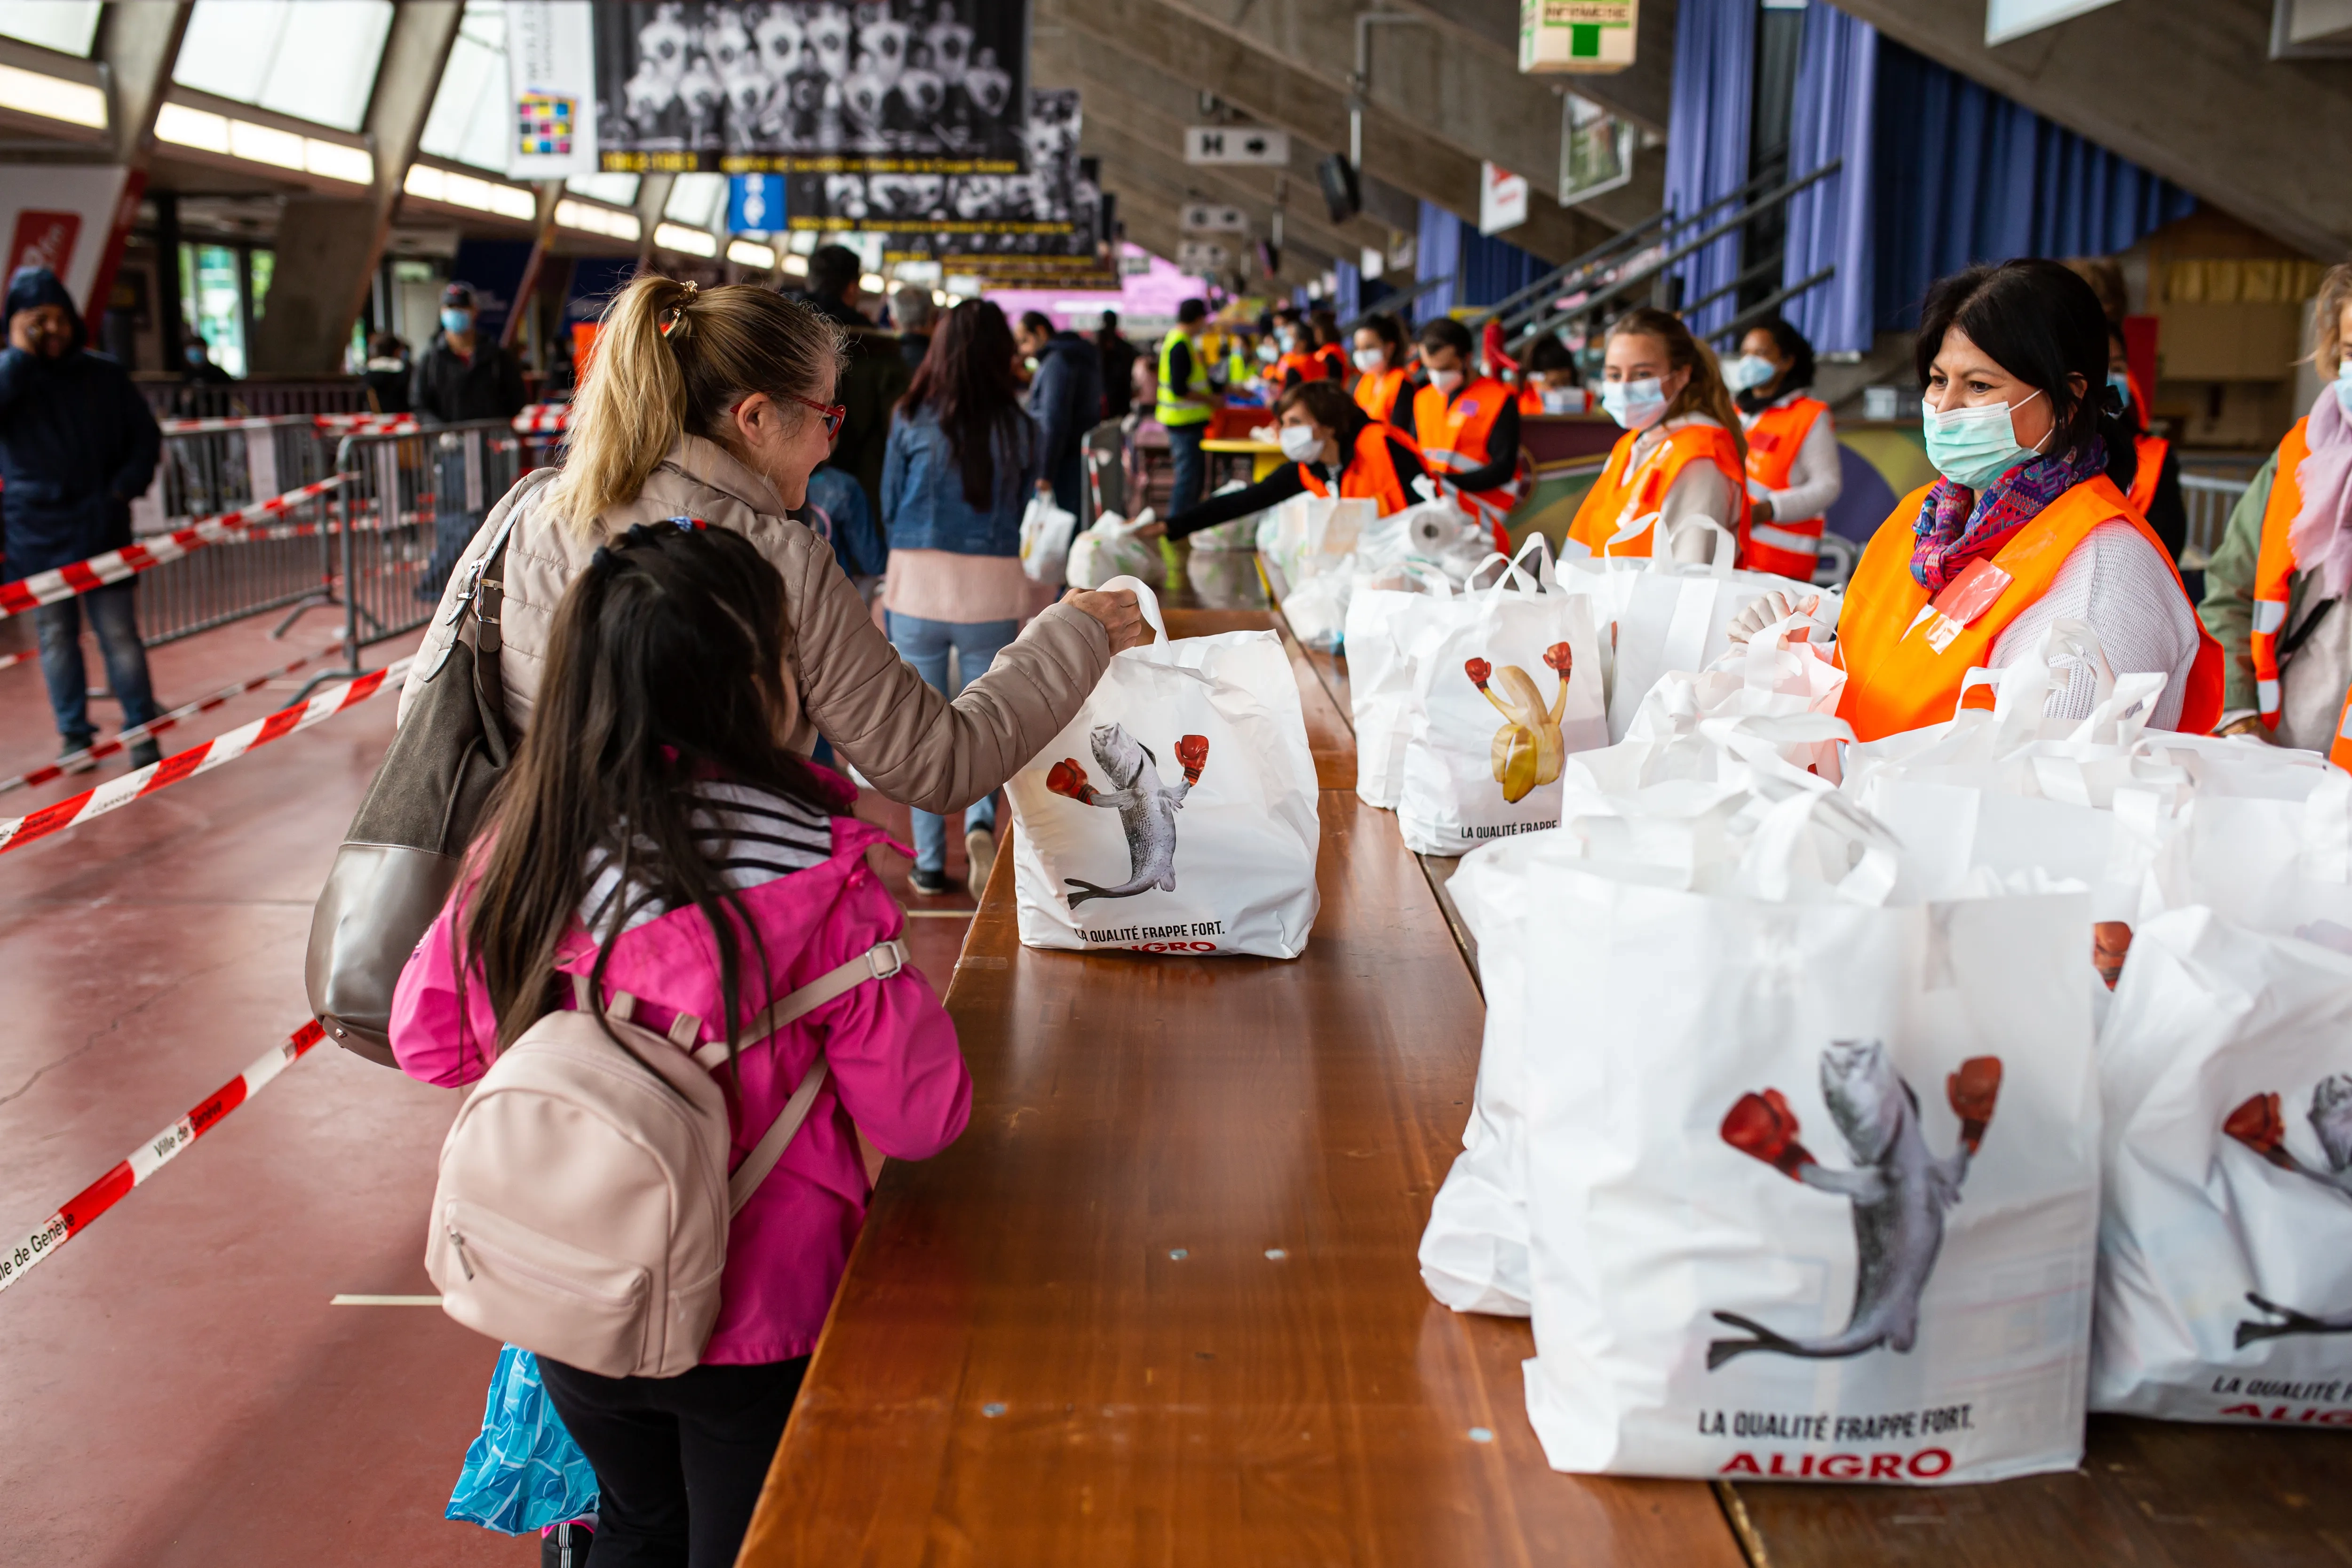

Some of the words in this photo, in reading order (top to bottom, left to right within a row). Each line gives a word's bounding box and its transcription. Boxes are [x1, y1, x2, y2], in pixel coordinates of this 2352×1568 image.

[1461, 827, 1473, 838] LA
[1477, 822, 1517, 838] QUALITÉ
[1090, 925, 1140, 942] QUALITÉ
[1142, 924, 1188, 939] FRAPPE
[1192, 921, 1225, 936] FORT.
[154, 1137, 175, 1157] Ville
[177, 1126, 188, 1142] de
[0, 1261, 12, 1281] le
[15, 1248, 31, 1267] de
[31, 1214, 75, 1253] Genève
[2212, 1374, 2242, 1394] LA
[2246, 1378, 2342, 1402] QUALITÉ
[1699, 1409, 1726, 1437] LA
[1733, 1409, 1828, 1441] QUALITÉ
[1834, 1412, 1917, 1442] FRAPPE
[1921, 1404, 1975, 1435] FORT.
[1720, 1448, 1952, 1479] ALIGRO
